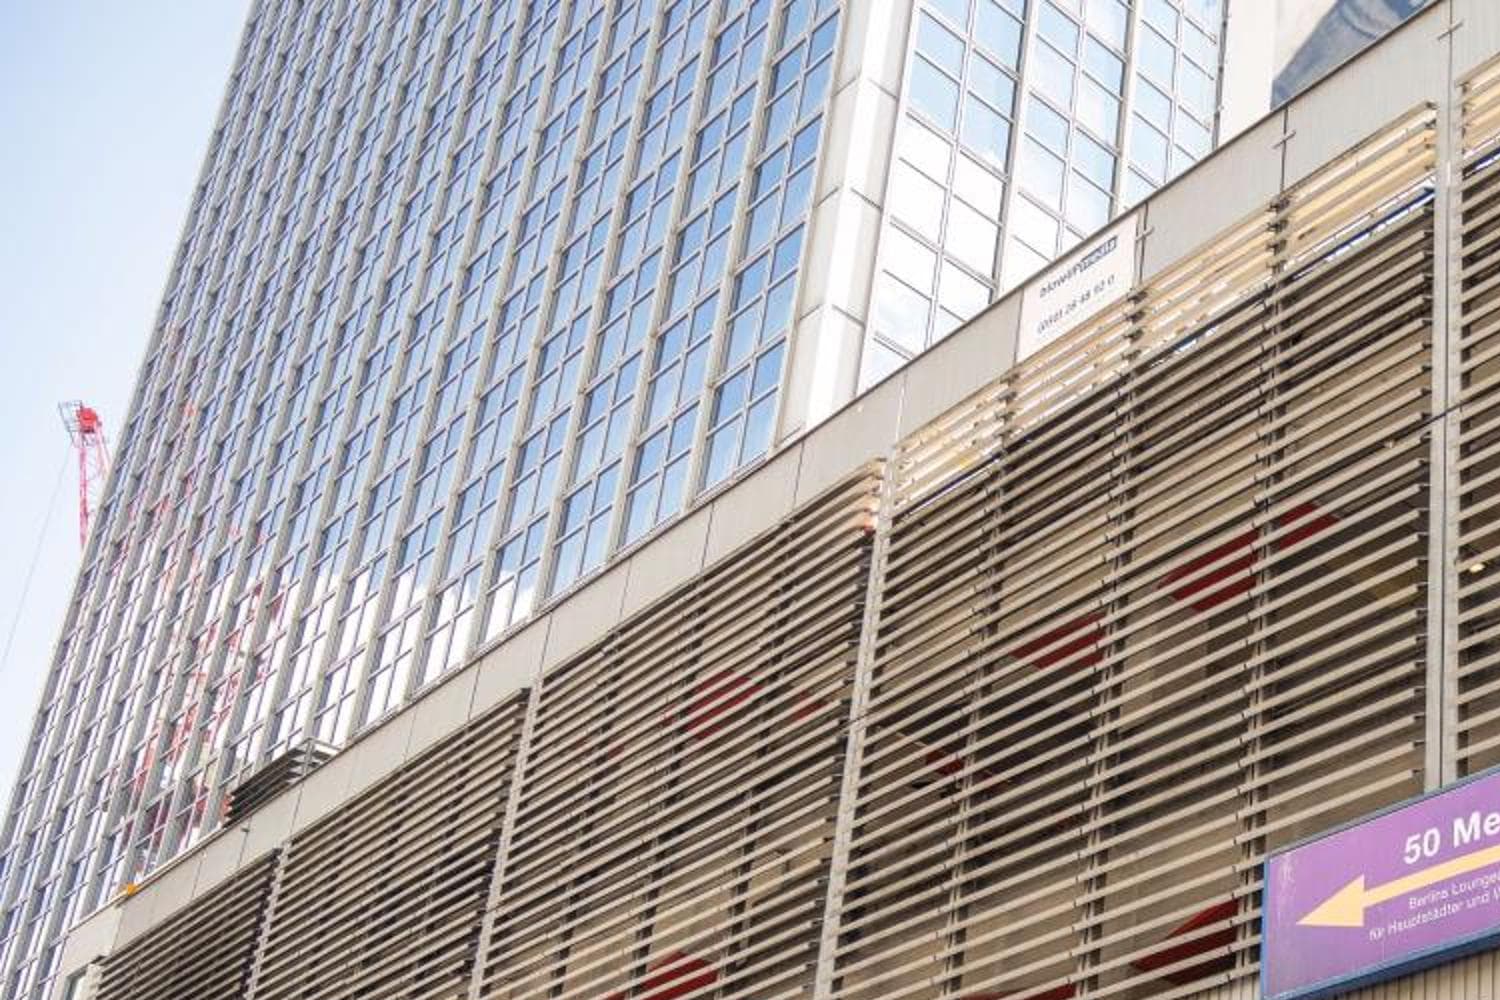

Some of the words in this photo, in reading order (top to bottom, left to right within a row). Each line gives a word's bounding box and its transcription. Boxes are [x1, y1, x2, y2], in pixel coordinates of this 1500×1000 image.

[1403, 827, 1440, 865] 50
[1408, 889, 1449, 910] Berlins
[1466, 893, 1490, 910] und
